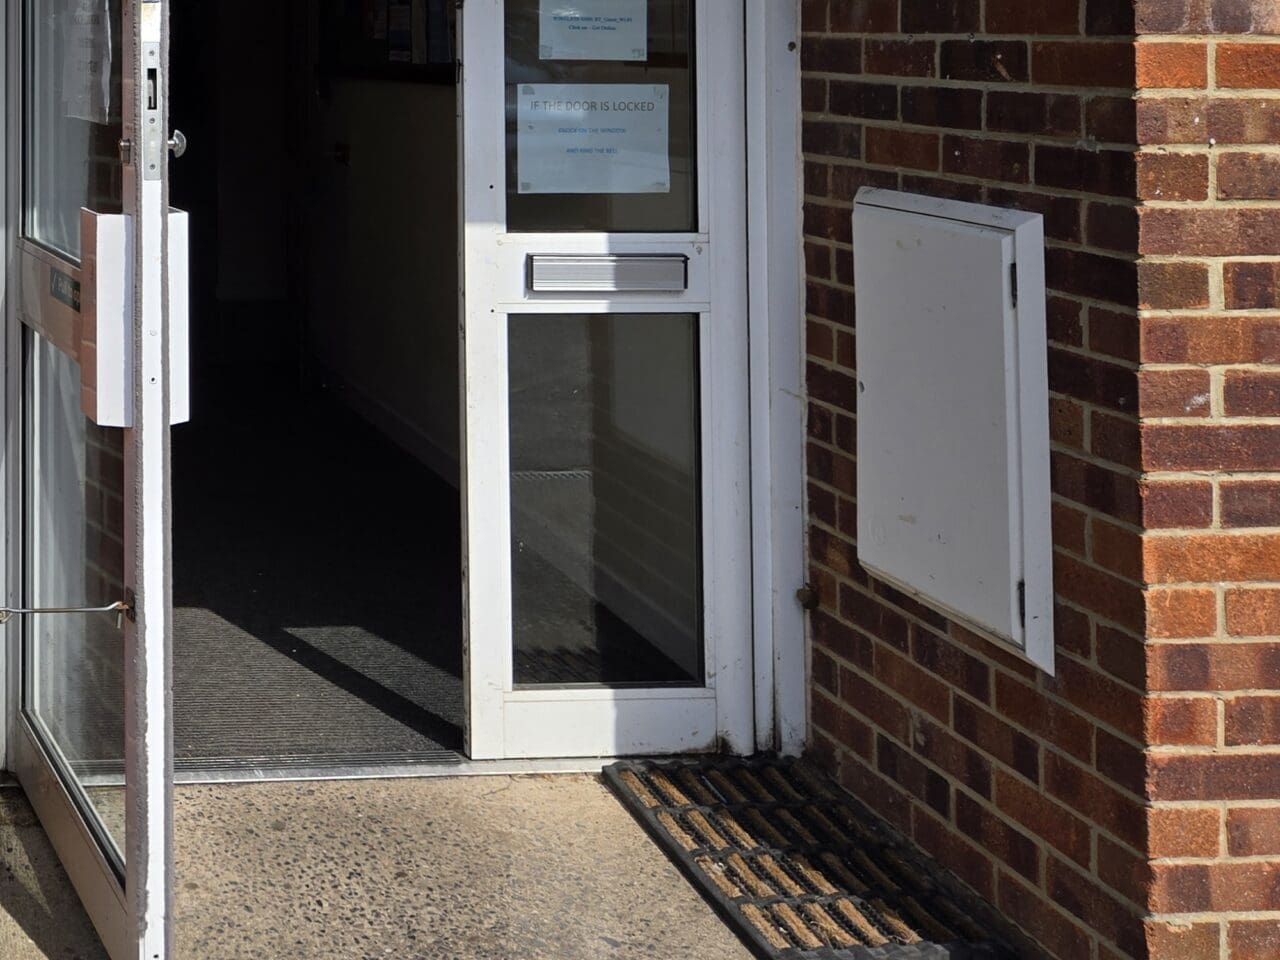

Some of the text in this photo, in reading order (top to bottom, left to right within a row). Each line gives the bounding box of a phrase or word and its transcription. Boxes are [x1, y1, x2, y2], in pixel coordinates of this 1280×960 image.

[530, 101, 655, 111] IF THE DOOR IS LOCKED
